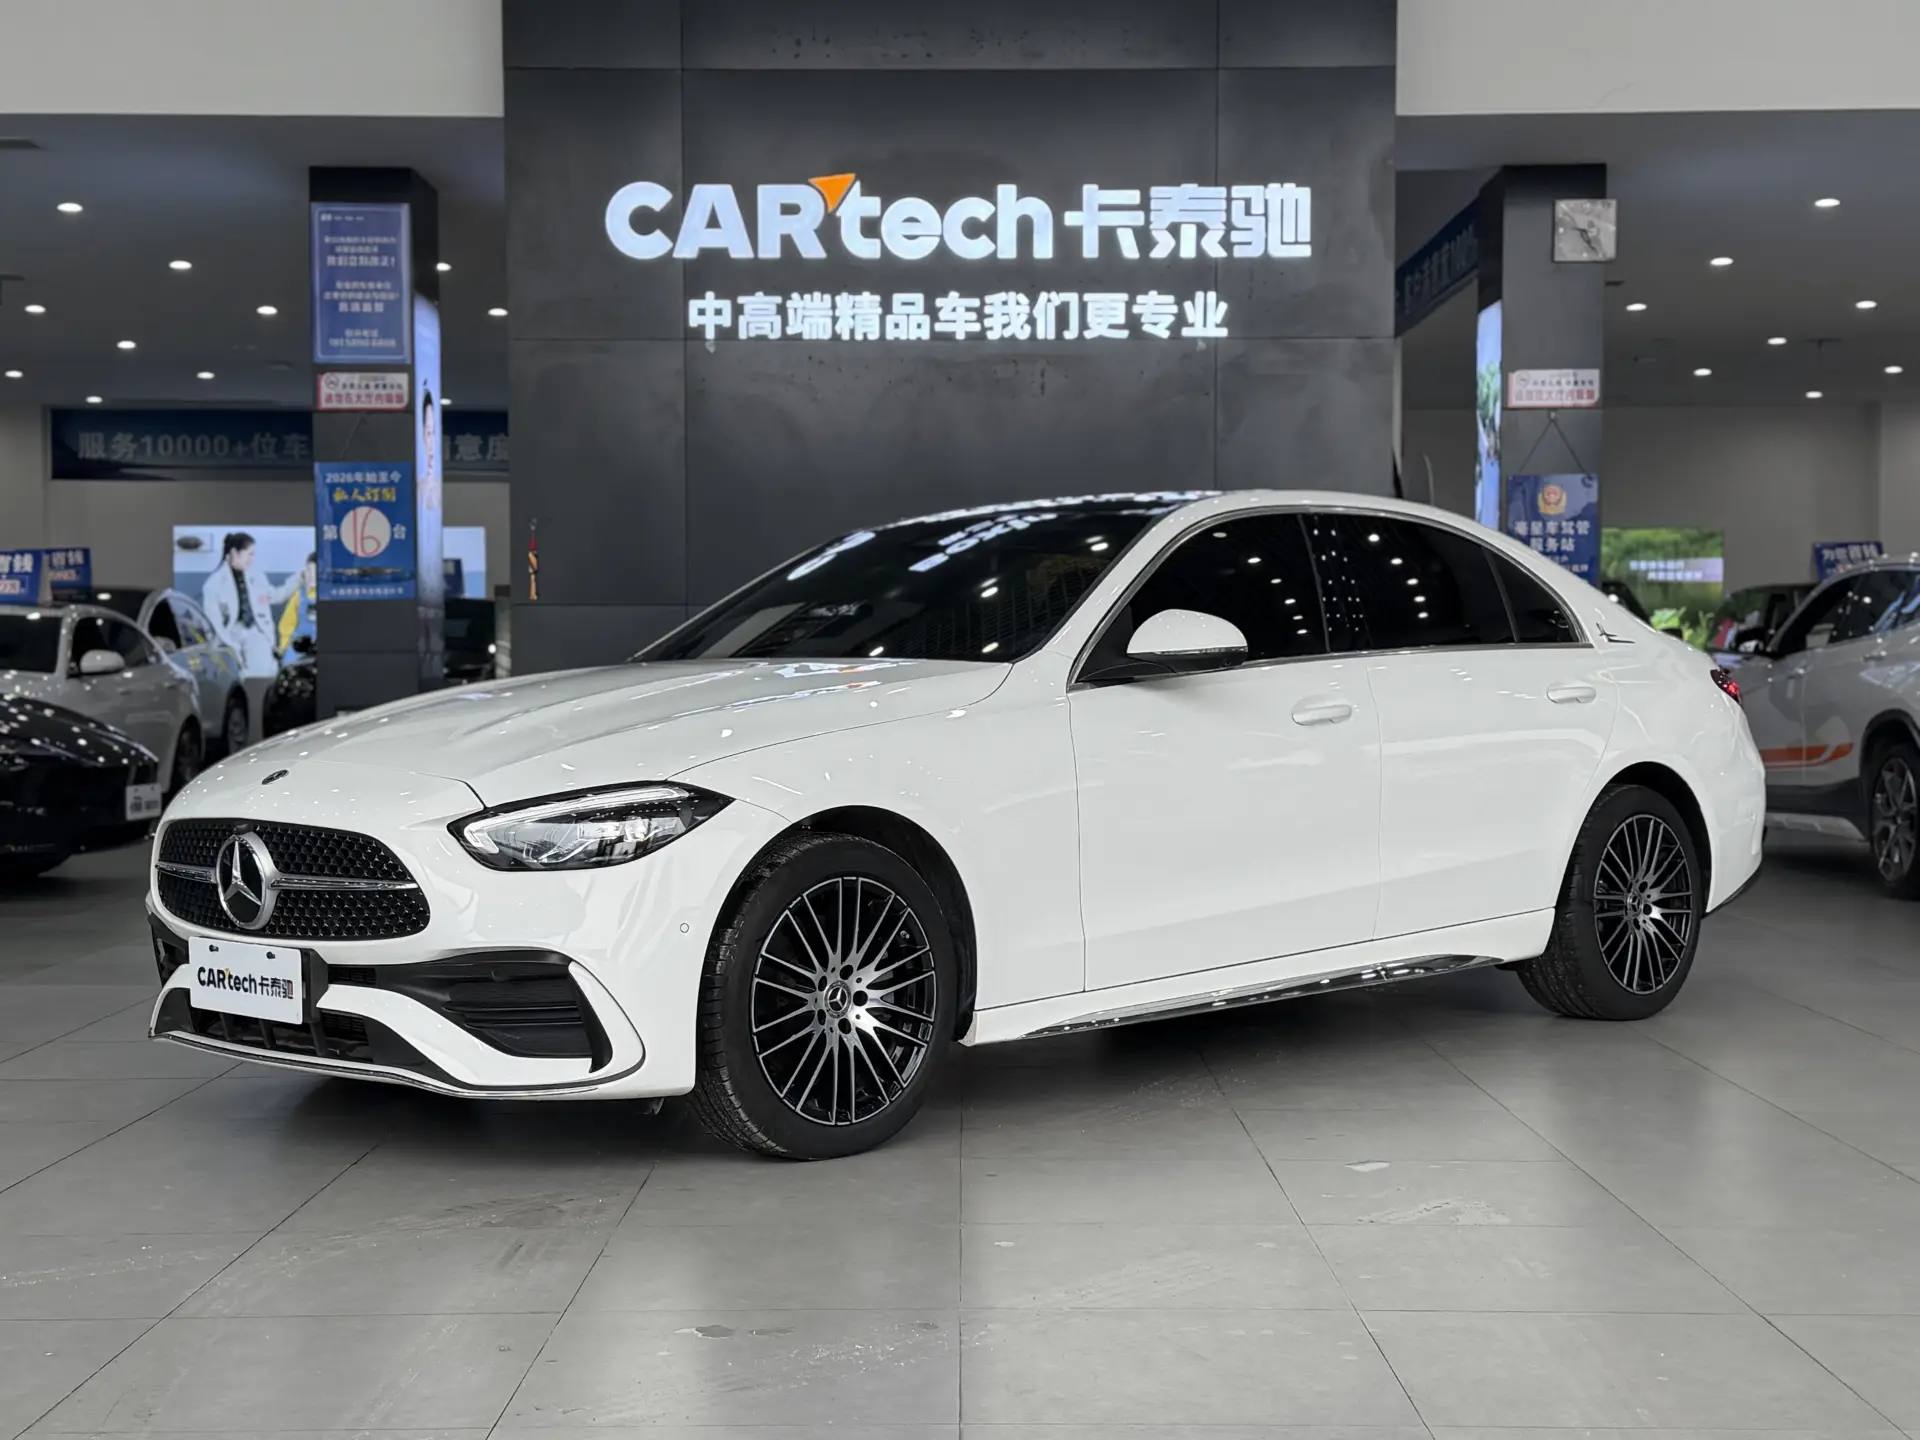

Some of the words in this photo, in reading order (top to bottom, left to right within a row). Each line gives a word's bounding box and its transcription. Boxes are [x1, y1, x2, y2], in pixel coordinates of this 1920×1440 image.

[604, 180, 1053, 261] CARtech
[1063, 183, 1312, 260] 卡泰驰
[688, 290, 1229, 341] 中高端精品车我们更专业
[352, 508, 382, 556] 16
[197, 966, 258, 995] CARtech
[258, 975, 294, 1000] 卡泰驰
